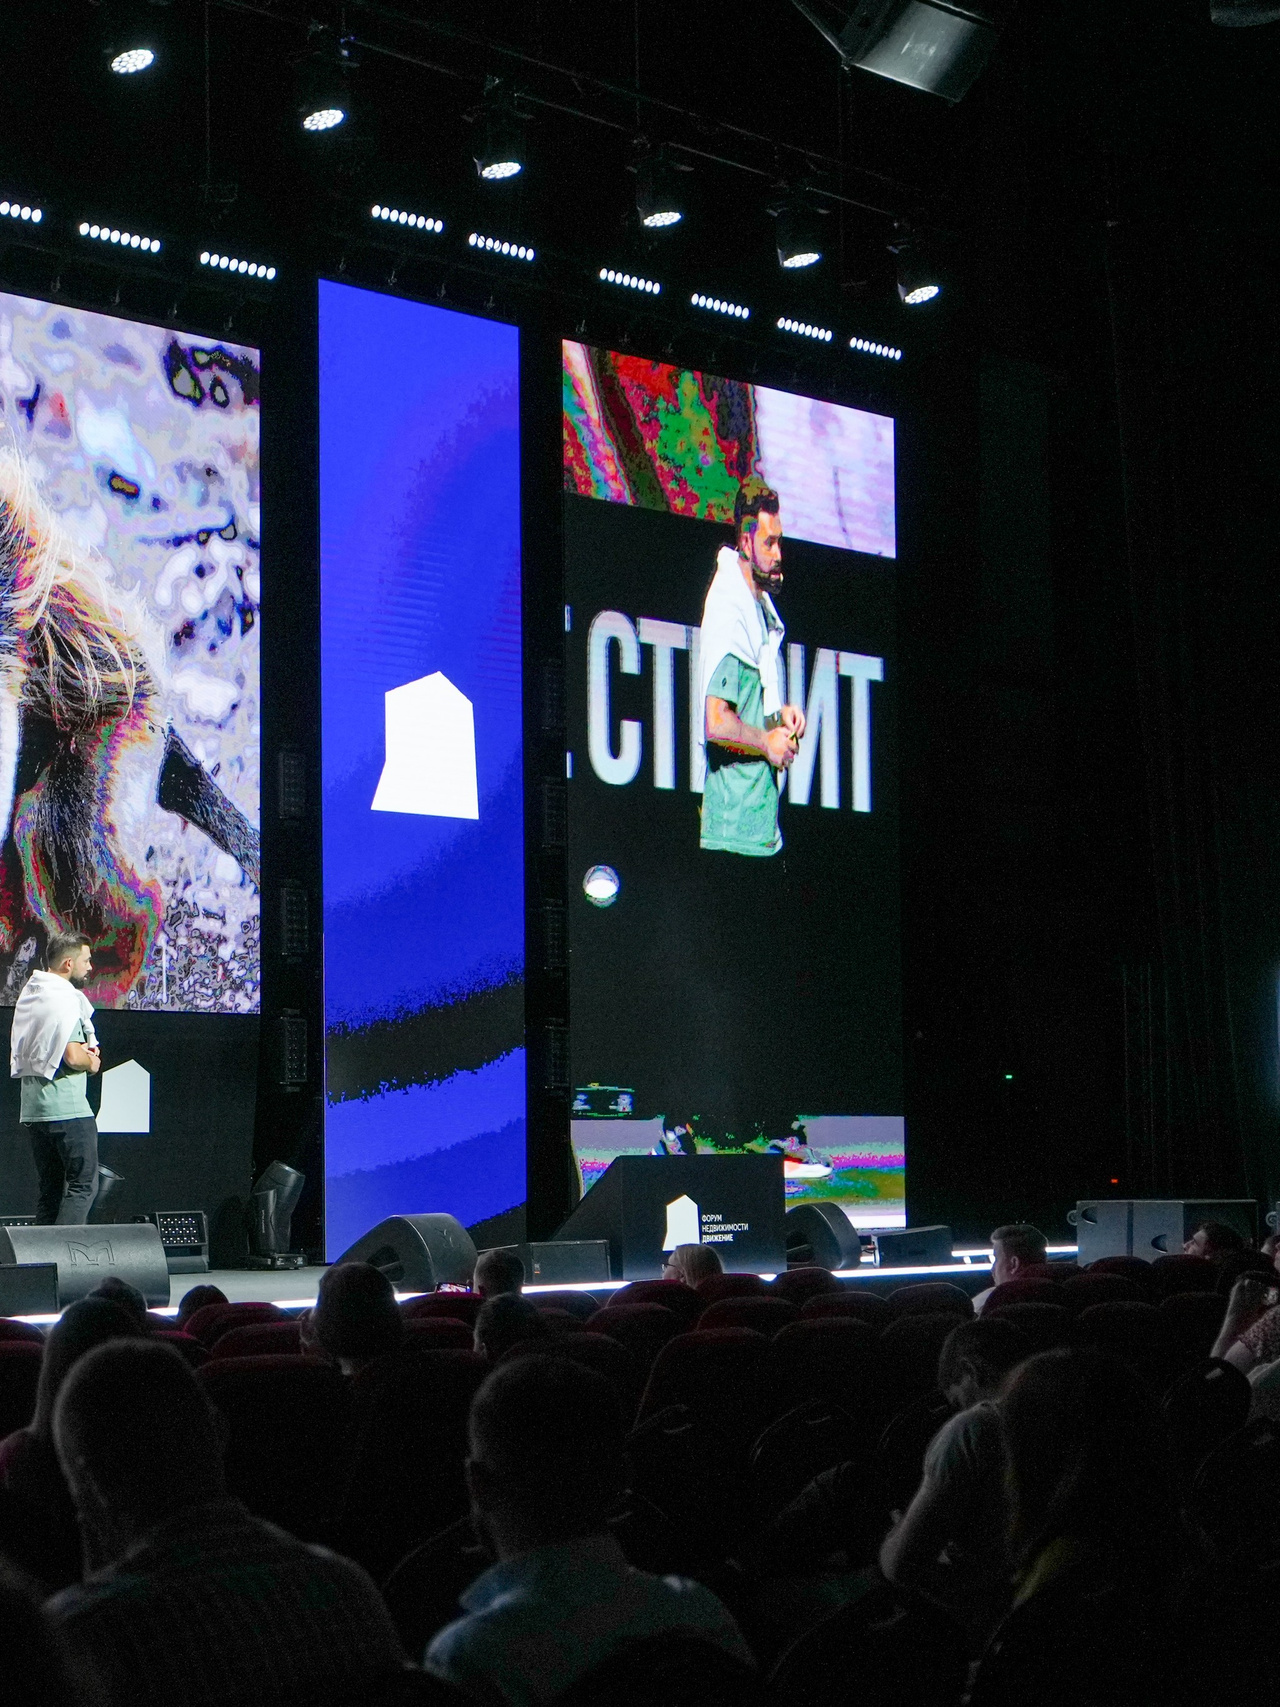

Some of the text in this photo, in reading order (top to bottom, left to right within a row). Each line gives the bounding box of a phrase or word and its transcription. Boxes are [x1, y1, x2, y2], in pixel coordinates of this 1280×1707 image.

[587, 610, 884, 813] СТИТ
[702, 1214, 723, 1222] ФОРУМ
[702, 1223, 748, 1233] НЕДВИЖИМОСТИ
[702, 1234, 733, 1243] ДВИЖЕНИЕ
